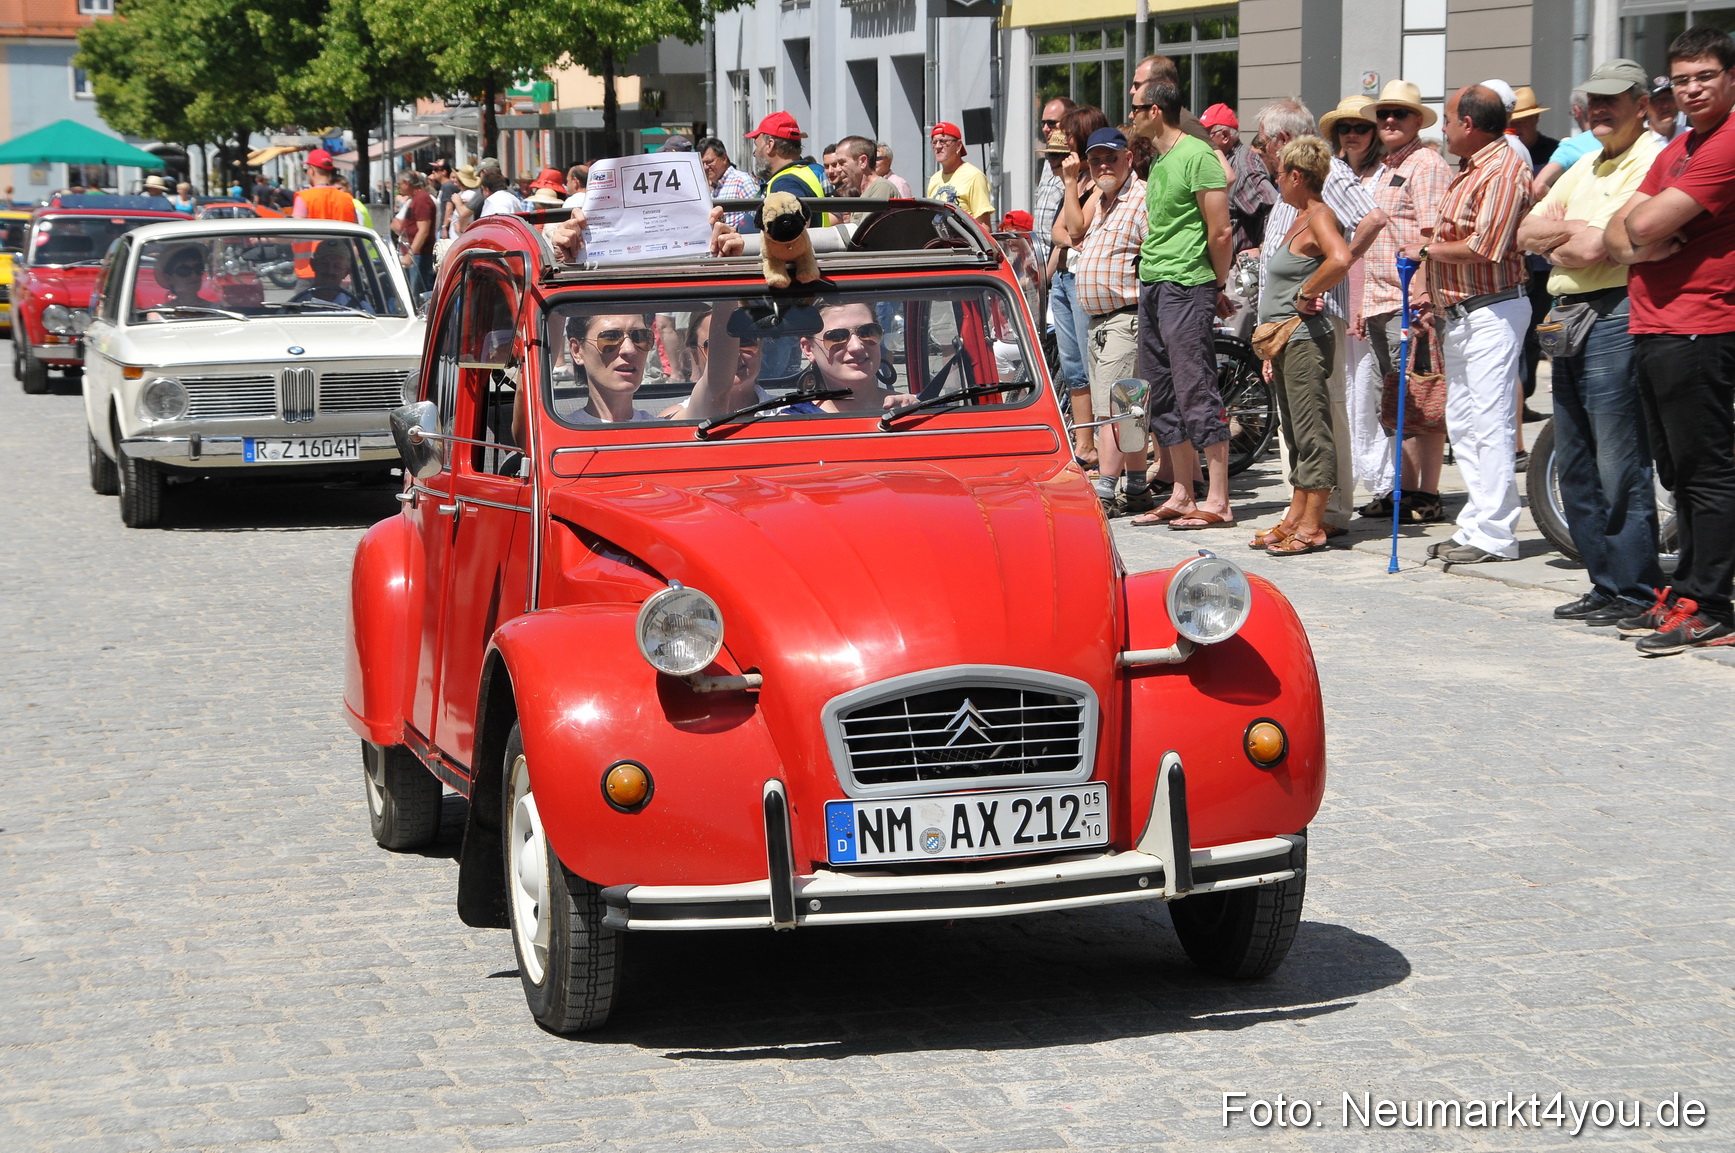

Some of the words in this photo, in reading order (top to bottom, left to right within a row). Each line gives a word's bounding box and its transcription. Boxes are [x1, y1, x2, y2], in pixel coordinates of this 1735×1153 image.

[633, 169, 681, 194] 474
[256, 441, 267, 459] R
[281, 440, 294, 458] Z
[298, 439, 357, 458] 1604H
[1083, 791, 1100, 805] 05
[857, 806, 913, 854] NM
[950, 800, 1001, 849] AX
[1011, 794, 1081, 844] 212
[1086, 823, 1101, 837] 10
[837, 839, 848, 852] D
